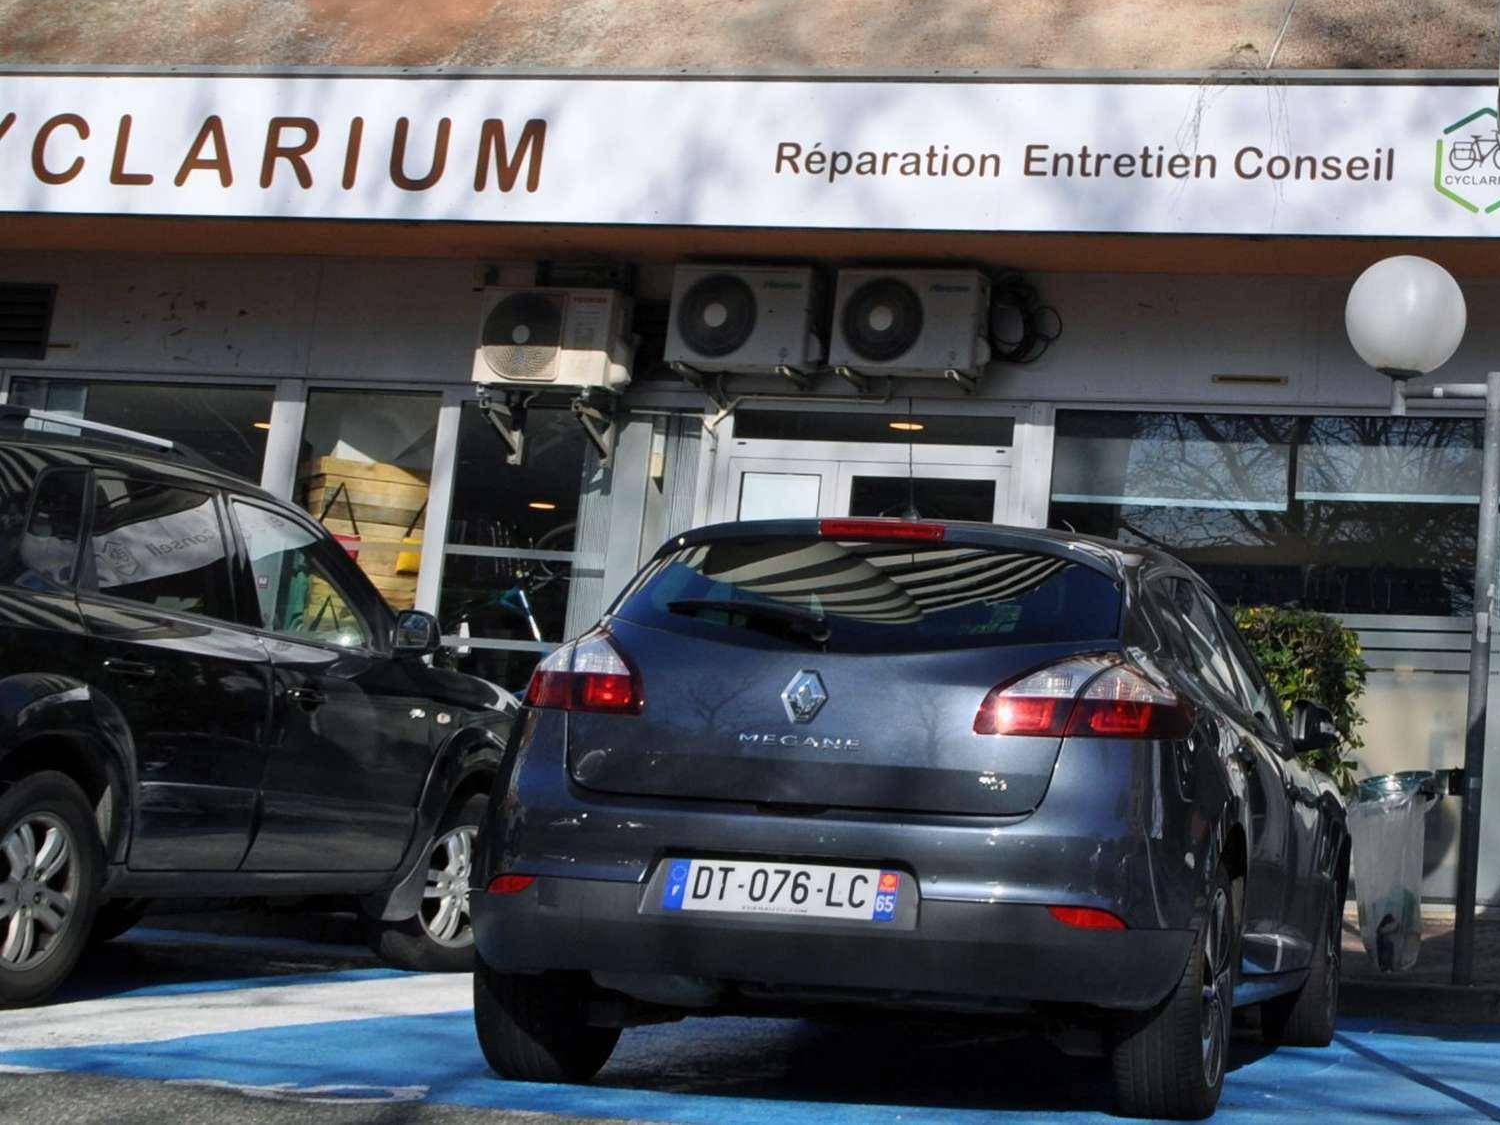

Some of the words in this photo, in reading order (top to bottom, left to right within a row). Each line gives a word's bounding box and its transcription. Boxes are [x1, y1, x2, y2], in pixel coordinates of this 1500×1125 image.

[774, 141, 1001, 184] Réparation
[1022, 143, 1217, 180] Entretien
[1233, 145, 1395, 182] Conseil
[739, 733, 860, 751] MEGANE
[692, 865, 869, 909] DT-076-LC
[876, 895, 894, 913] 65
